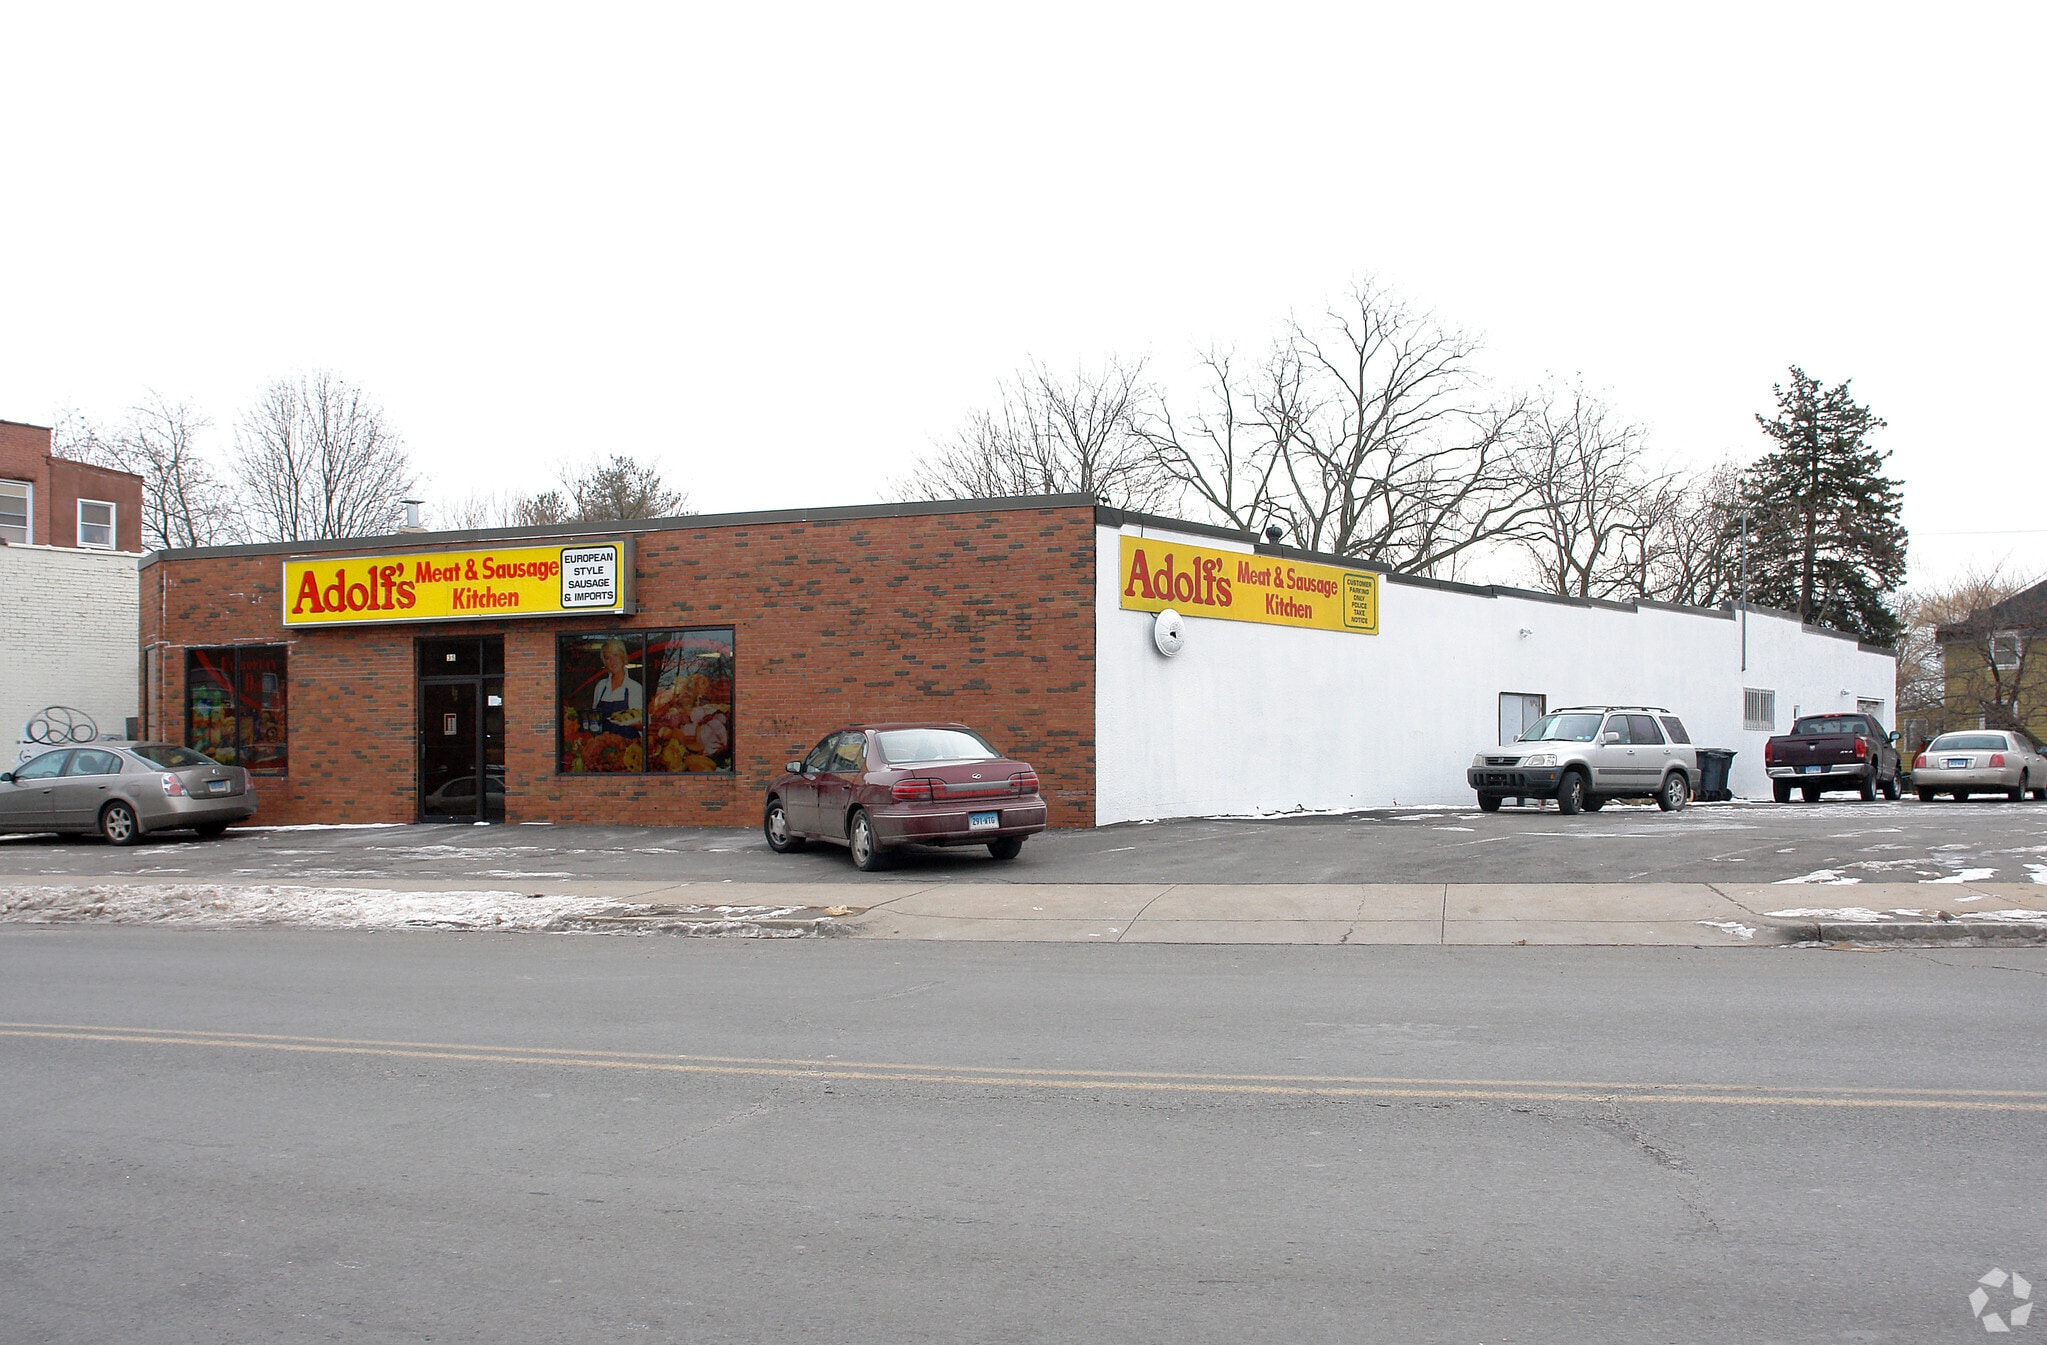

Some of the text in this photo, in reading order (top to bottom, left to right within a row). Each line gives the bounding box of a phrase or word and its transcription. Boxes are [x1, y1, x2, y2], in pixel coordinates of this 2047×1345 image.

[564, 552, 613, 564] EUROPEAN
[415, 556, 559, 584] Meat & Sausage
[574, 565, 604, 576] STYLE
[1124, 549, 1233, 607] Adolf's
[292, 562, 416, 614] Adolf's
[568, 578, 610, 589] SAUSAGE
[1237, 560, 1338, 599] Meat & Sausage
[1347, 579, 1372, 587] CUSTOMER
[452, 587, 519, 610] Kitchen
[564, 590, 614, 602] & IMPORTS
[1349, 587, 1369, 595] PARKING
[1265, 593, 1313, 619] Kitchen
